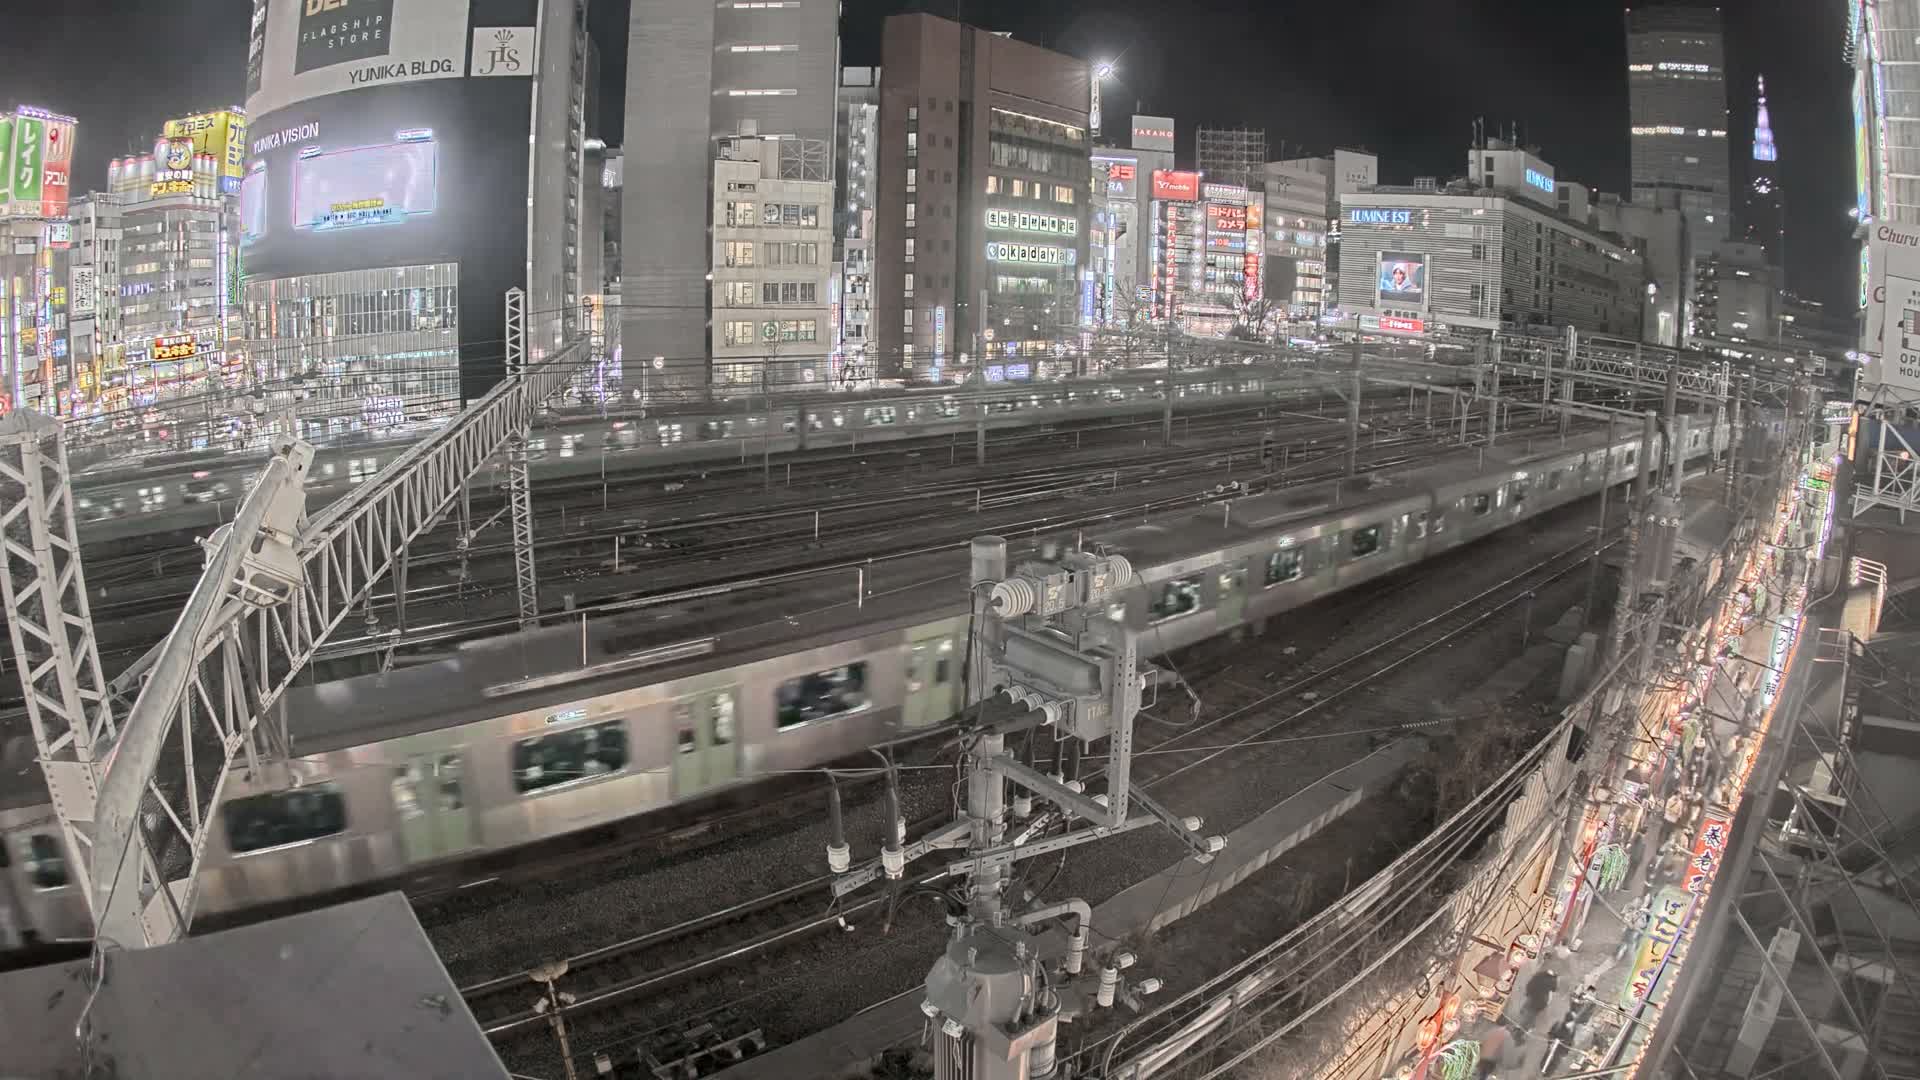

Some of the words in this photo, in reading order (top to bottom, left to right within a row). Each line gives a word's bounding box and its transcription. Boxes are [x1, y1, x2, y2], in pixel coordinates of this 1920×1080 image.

[306, 0, 348, 16] DE
[303, 15, 383, 43] FLAGSHIP
[328, 29, 382, 48] STORE
[349, 64, 408, 84] YUNIKA
[411, 59, 455, 76] BLDG.
[253, 132, 281, 155] YUNIKA
[281, 122, 319, 145] VISION
[1134, 128, 1174, 138] TAKANO
[20, 122, 36, 189] レイク
[45, 170, 68, 186] アコム
[1208, 206, 1246, 218] ヨドバシ
[1351, 209, 1391, 223] LUMINE
[1392, 210, 1411, 223] EST
[1217, 219, 1246, 230] カメラ
[1878, 226, 1919, 247] Churu
[1000, 244, 1065, 260] okadaya
[1900, 353, 1920, 367] OP
[363, 396, 404, 409] Alpen
[363, 411, 405, 424] TOKYO
